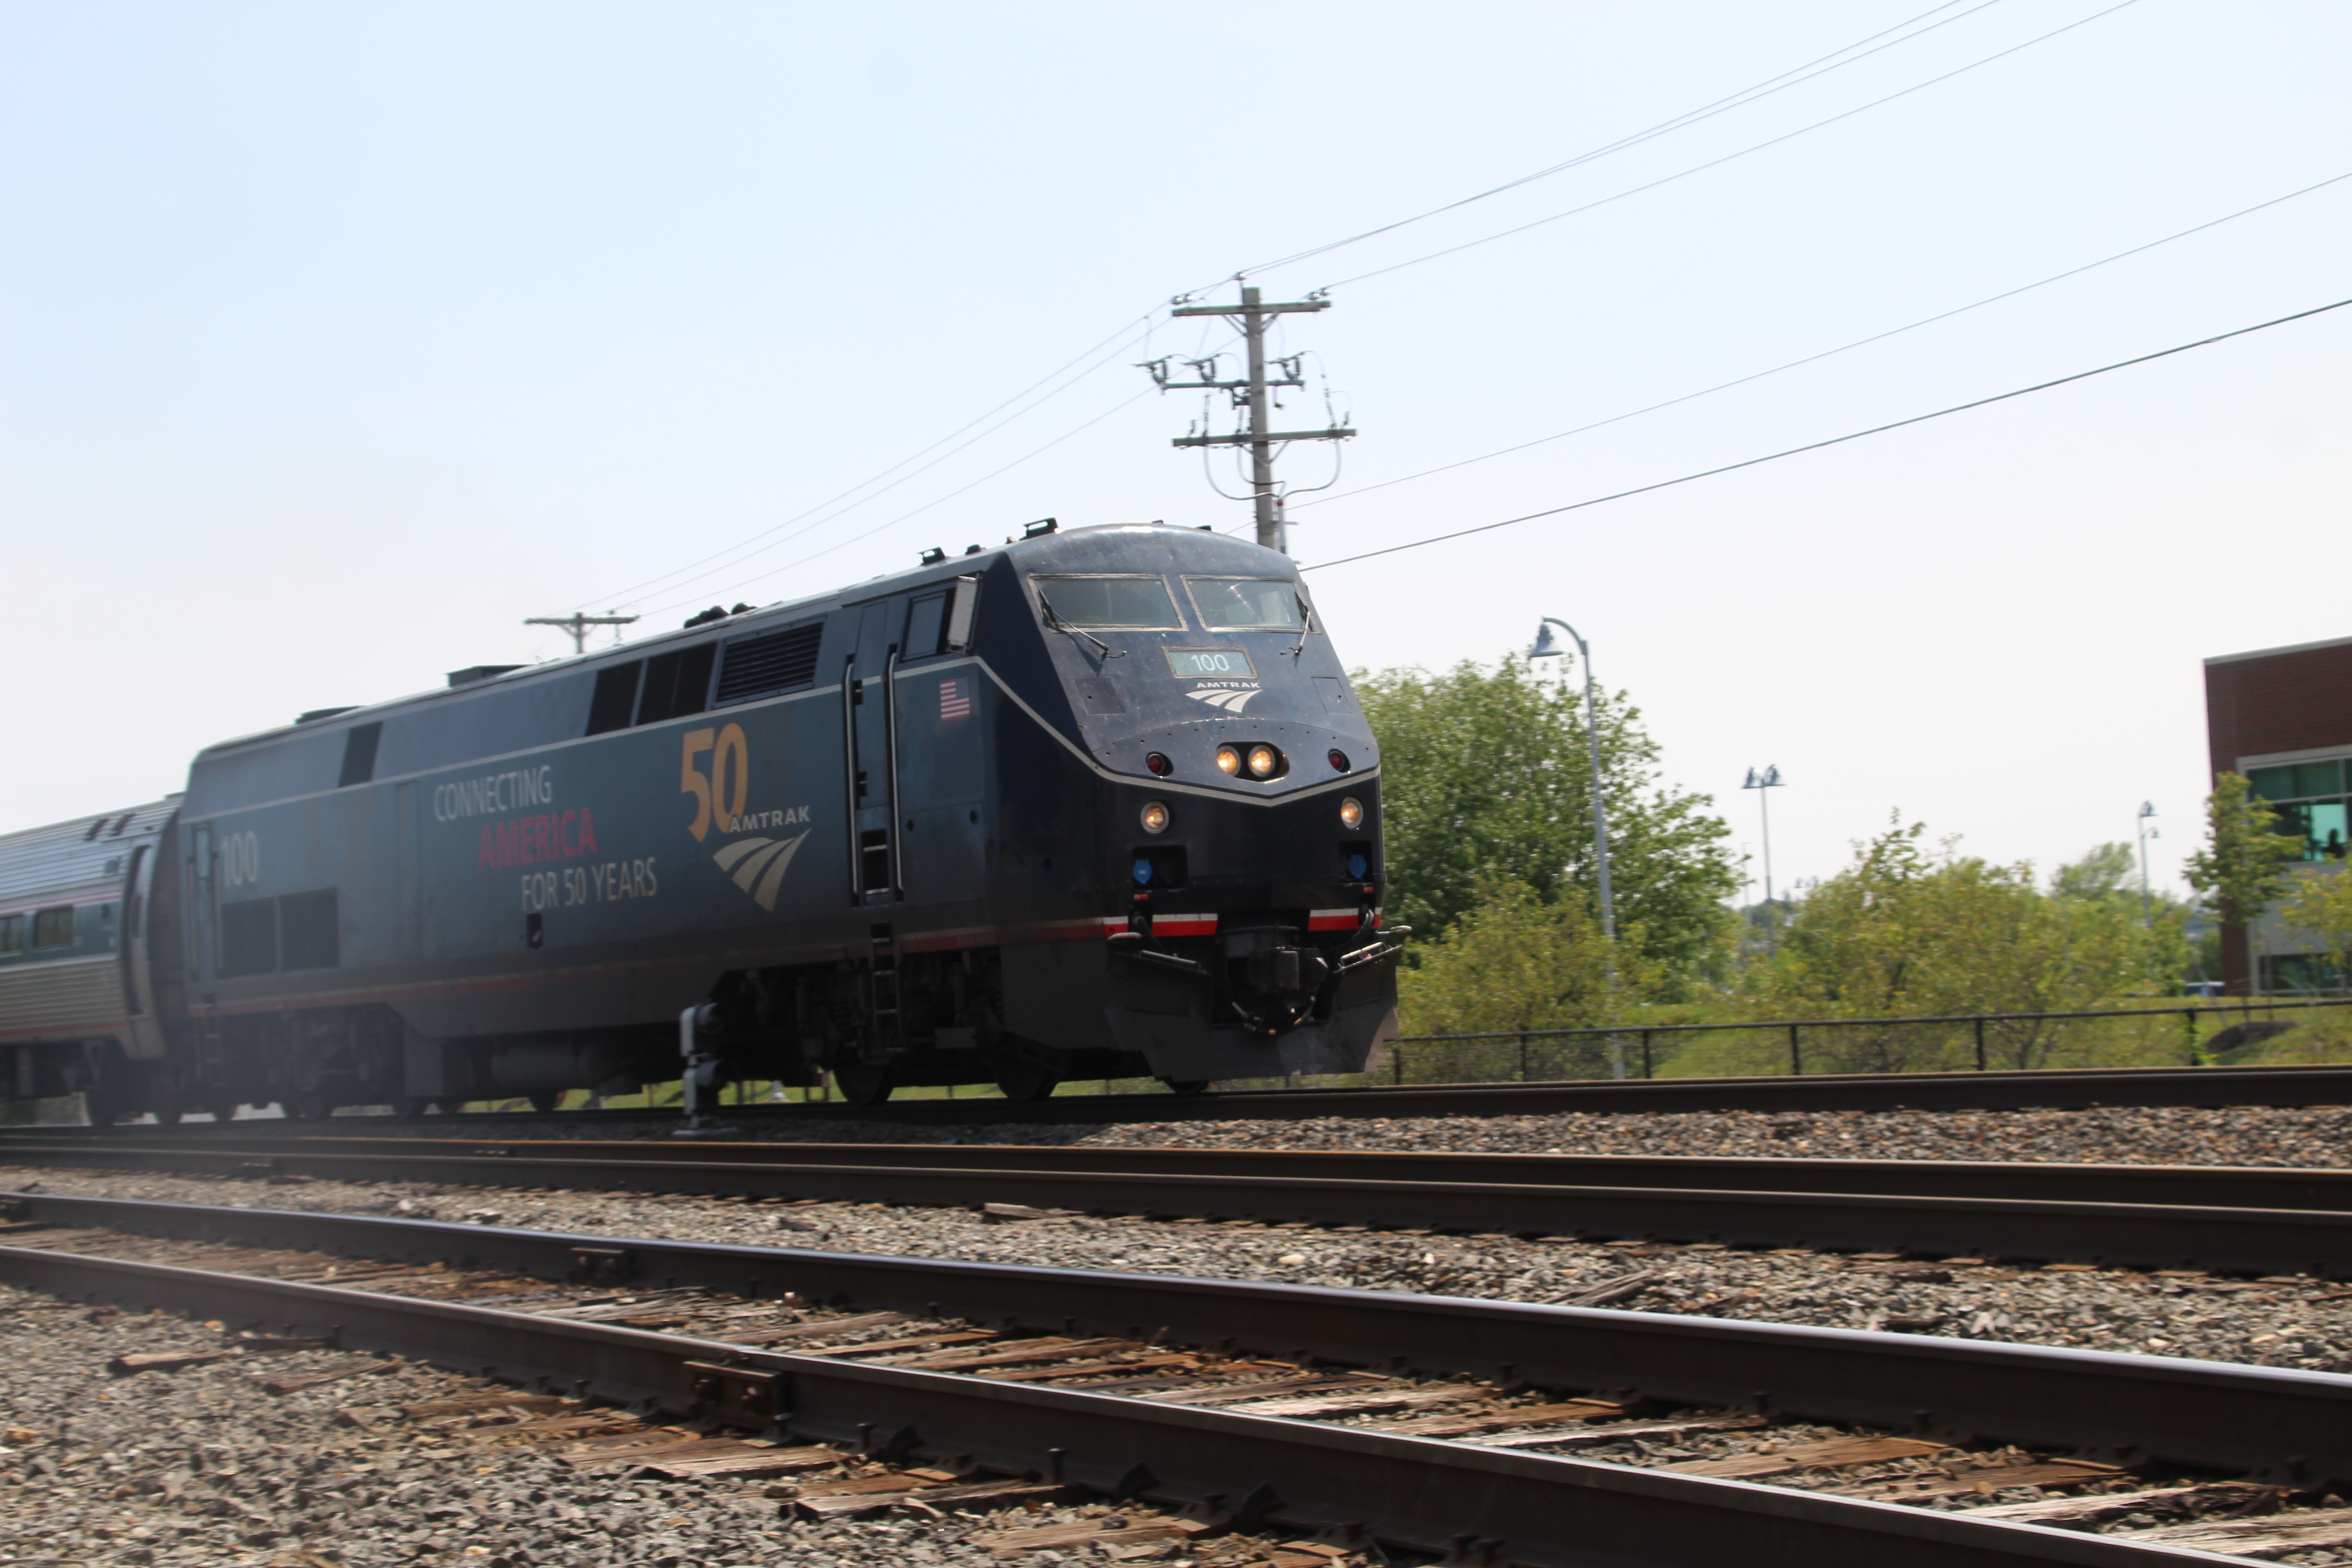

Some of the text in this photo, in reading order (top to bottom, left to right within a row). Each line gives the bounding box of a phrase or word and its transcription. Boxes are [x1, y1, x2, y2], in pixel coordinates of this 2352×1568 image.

[1191, 654, 1230, 671] 100
[434, 765, 551, 821] CONNECTING
[681, 723, 748, 842] 50
[478, 808, 598, 870] AMERICA
[729, 805, 810, 833] AMTRAK
[221, 831, 258, 886] 100
[521, 857, 657, 910] FOR 50 YEARS
